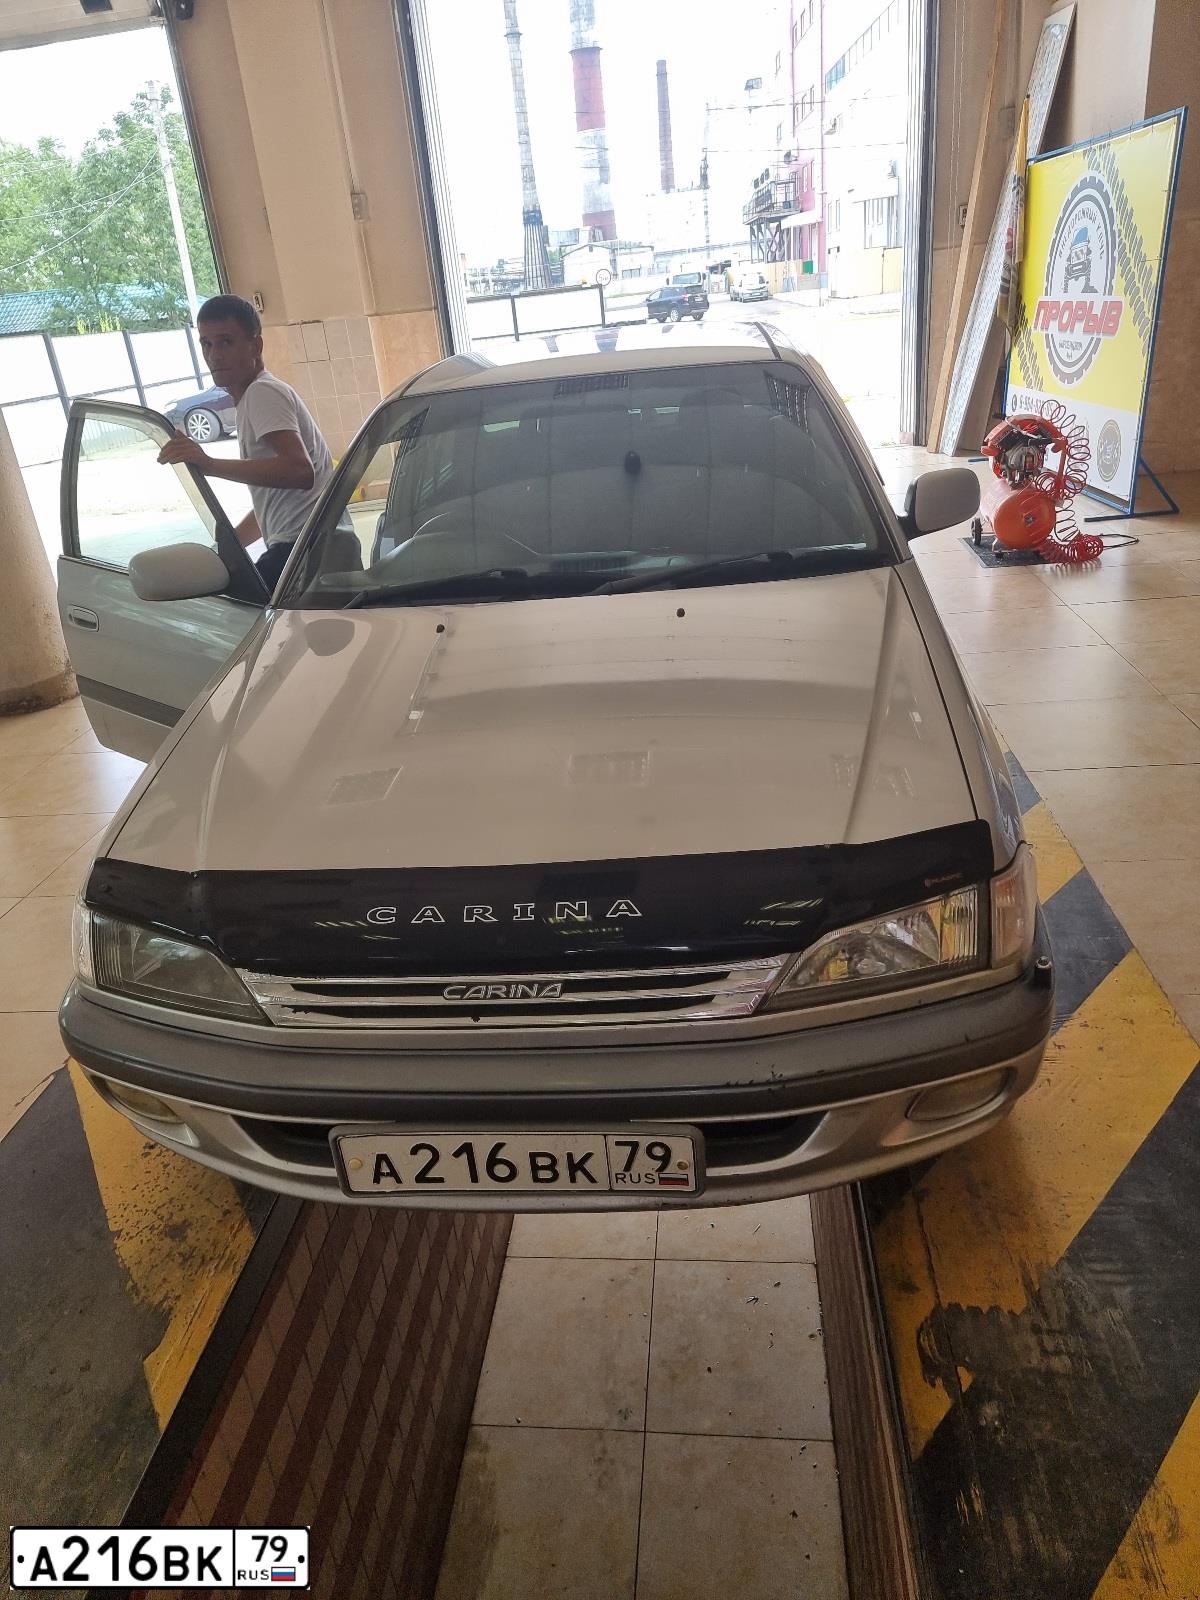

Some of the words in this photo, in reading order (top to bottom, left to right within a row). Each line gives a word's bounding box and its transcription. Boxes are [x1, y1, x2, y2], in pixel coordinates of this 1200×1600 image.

[1033, 301, 1123, 335] ПРОРЫВ
[366, 899, 643, 924] CARINA
[442, 982, 563, 1001] CARINA
[371, 1141, 598, 1185] А216ВК
[615, 1140, 672, 1173] 79
[614, 1172, 657, 1185] RUS
